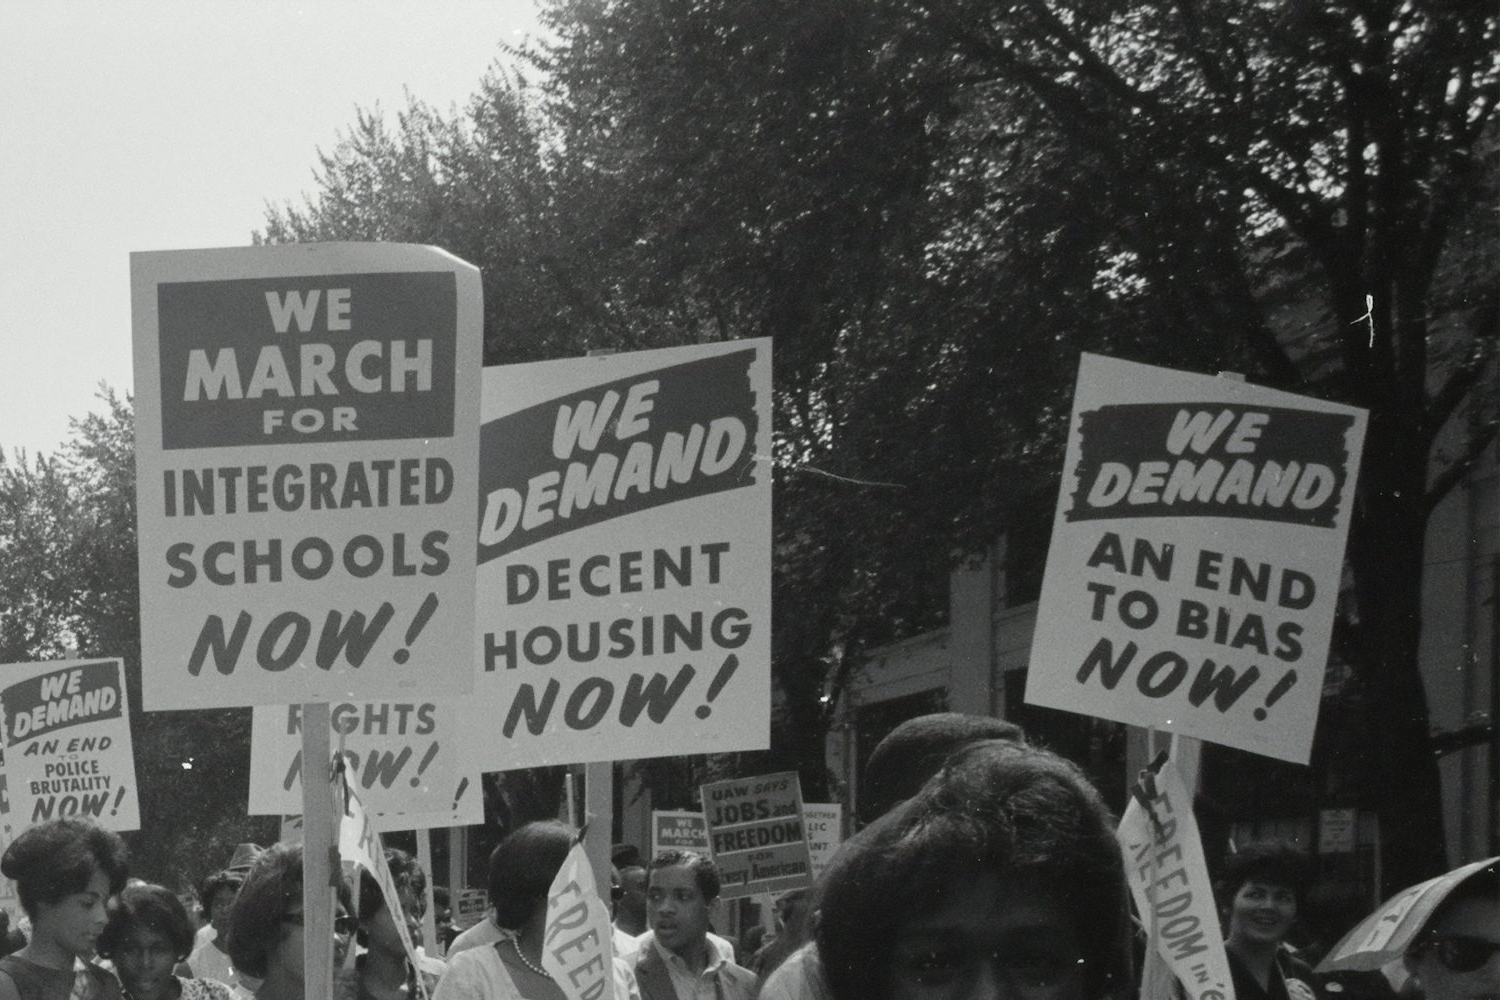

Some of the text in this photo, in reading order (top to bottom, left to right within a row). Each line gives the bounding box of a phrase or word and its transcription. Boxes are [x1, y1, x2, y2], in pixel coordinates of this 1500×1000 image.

[265, 288, 352, 333] WE
[183, 338, 433, 401] MARCH
[262, 406, 359, 435] FOR
[552, 379, 659, 459] WE
[1166, 409, 1269, 455] WE
[163, 457, 454, 518] INTEGRATED
[479, 416, 747, 546] DEMAND
[1086, 458, 1336, 510] DEMAND
[164, 529, 451, 589] SCHOOLS
[506, 541, 731, 606] DECENT
[1086, 532, 1316, 610] AN END
[187, 592, 439, 677] NOW!
[483, 606, 752, 672] HOUSING
[1086, 581, 1304, 663] TO BIAS
[41, 669, 82, 700] WE
[501, 653, 740, 739] NOW!
[1075, 636, 1298, 722] NOW!
[13, 686, 116, 737] DEMAND
[287, 703, 436, 735] RGHTS
[24, 736, 112, 757] AN END
[45, 760, 99, 778] POLICE
[30, 775, 111, 795] BRUTALITY
[31, 785, 126, 822] NOW!
[711, 780, 789, 801] UAW SAYS
[661, 828, 707, 838] MARCH
[711, 801, 797, 826] JOBS and
[713, 822, 801, 855] FREEDOM
[1135, 790, 1209, 961] FREEDOM
[1191, 963, 1210, 984] IN
